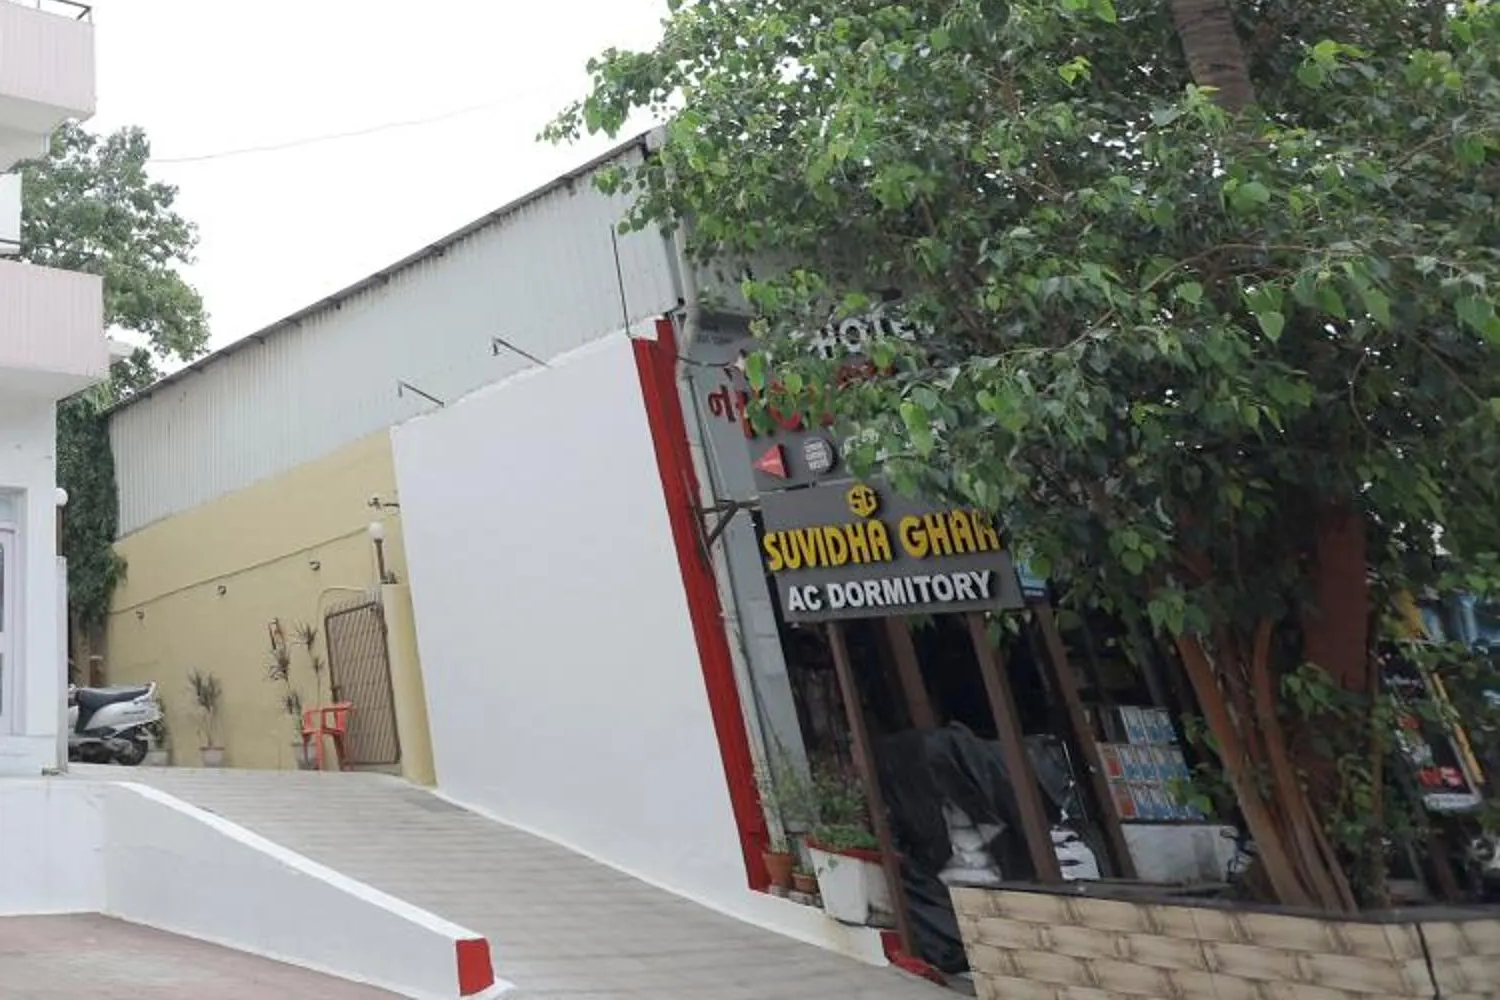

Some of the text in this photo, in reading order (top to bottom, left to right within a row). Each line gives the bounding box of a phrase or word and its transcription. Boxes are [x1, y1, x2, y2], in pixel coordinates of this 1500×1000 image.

[764, 520, 892, 571] SUVIDHA
[788, 568, 993, 612] AC DORMITORY
